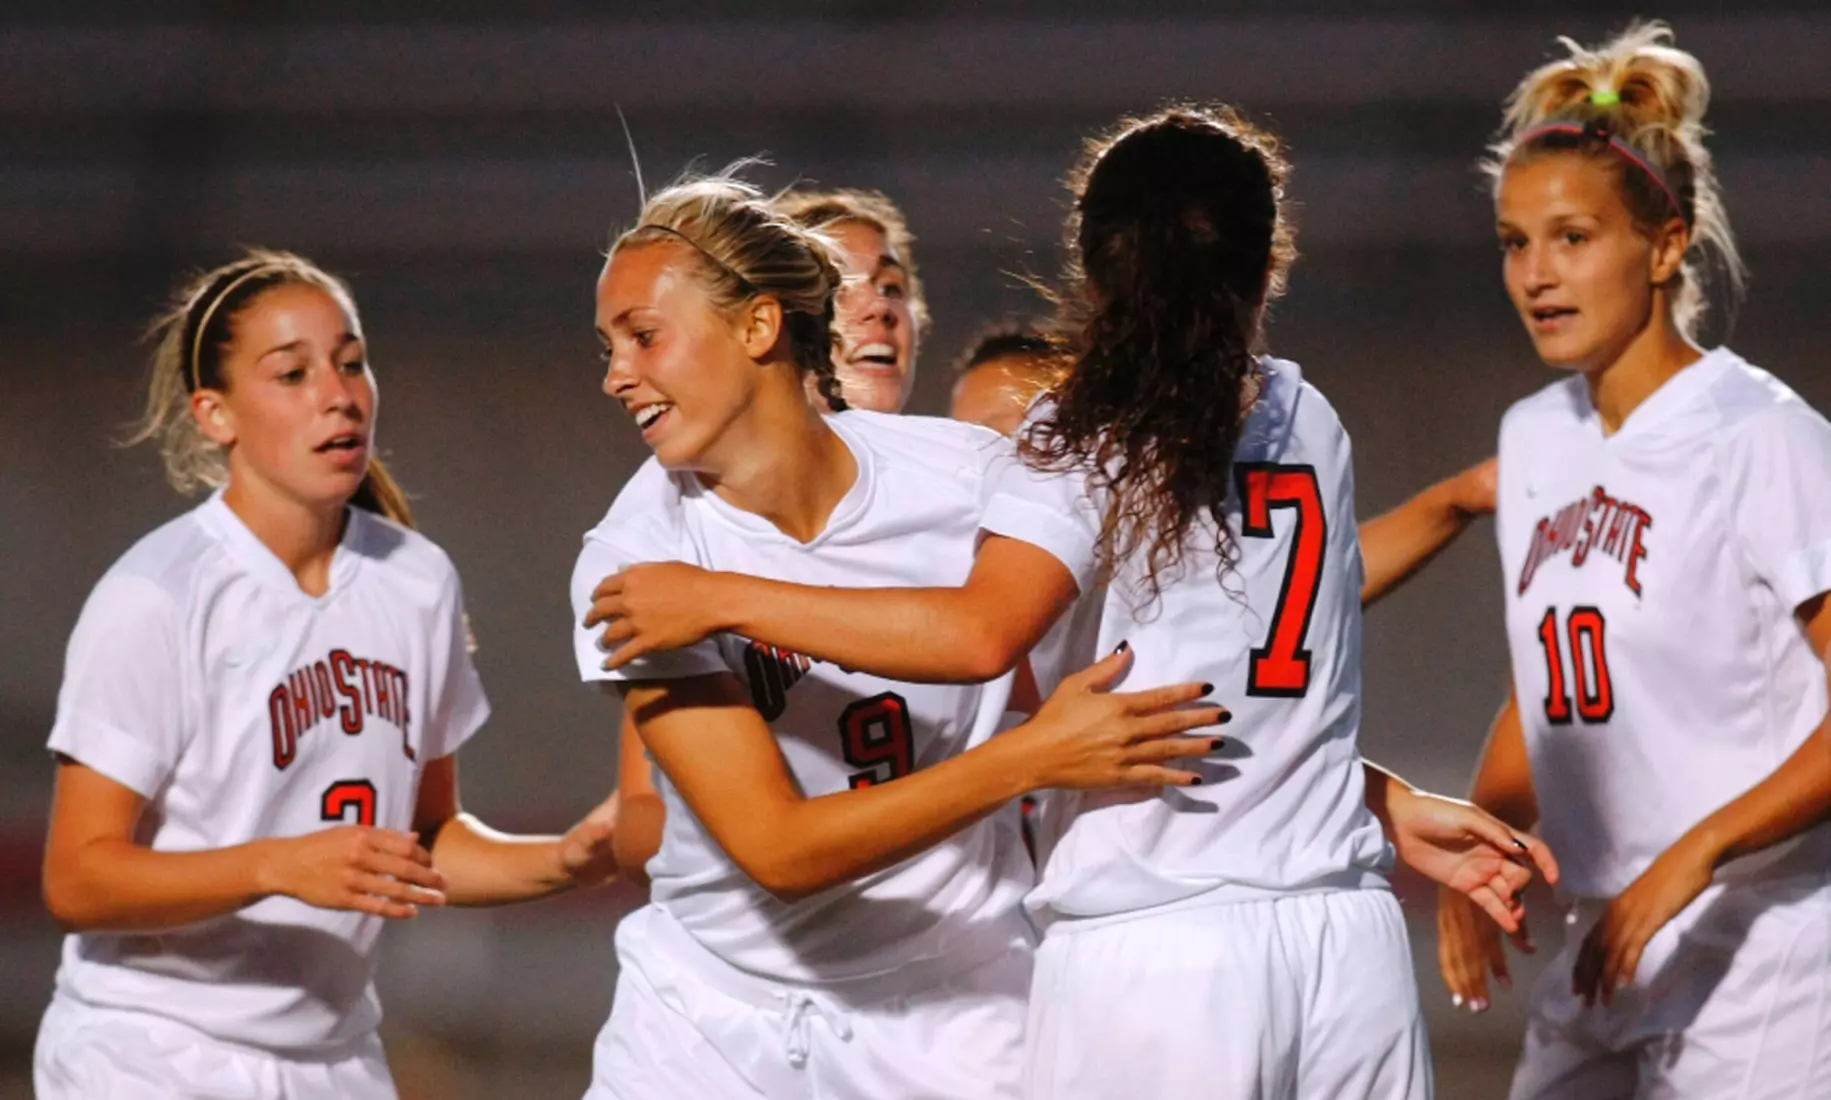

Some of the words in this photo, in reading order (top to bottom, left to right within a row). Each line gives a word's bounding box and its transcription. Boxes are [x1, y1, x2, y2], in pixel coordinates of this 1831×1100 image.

[1234, 461, 1327, 698] 7
[269, 661, 337, 772] OHIO
[1538, 606, 1614, 725] 10
[838, 690, 914, 790] 9
